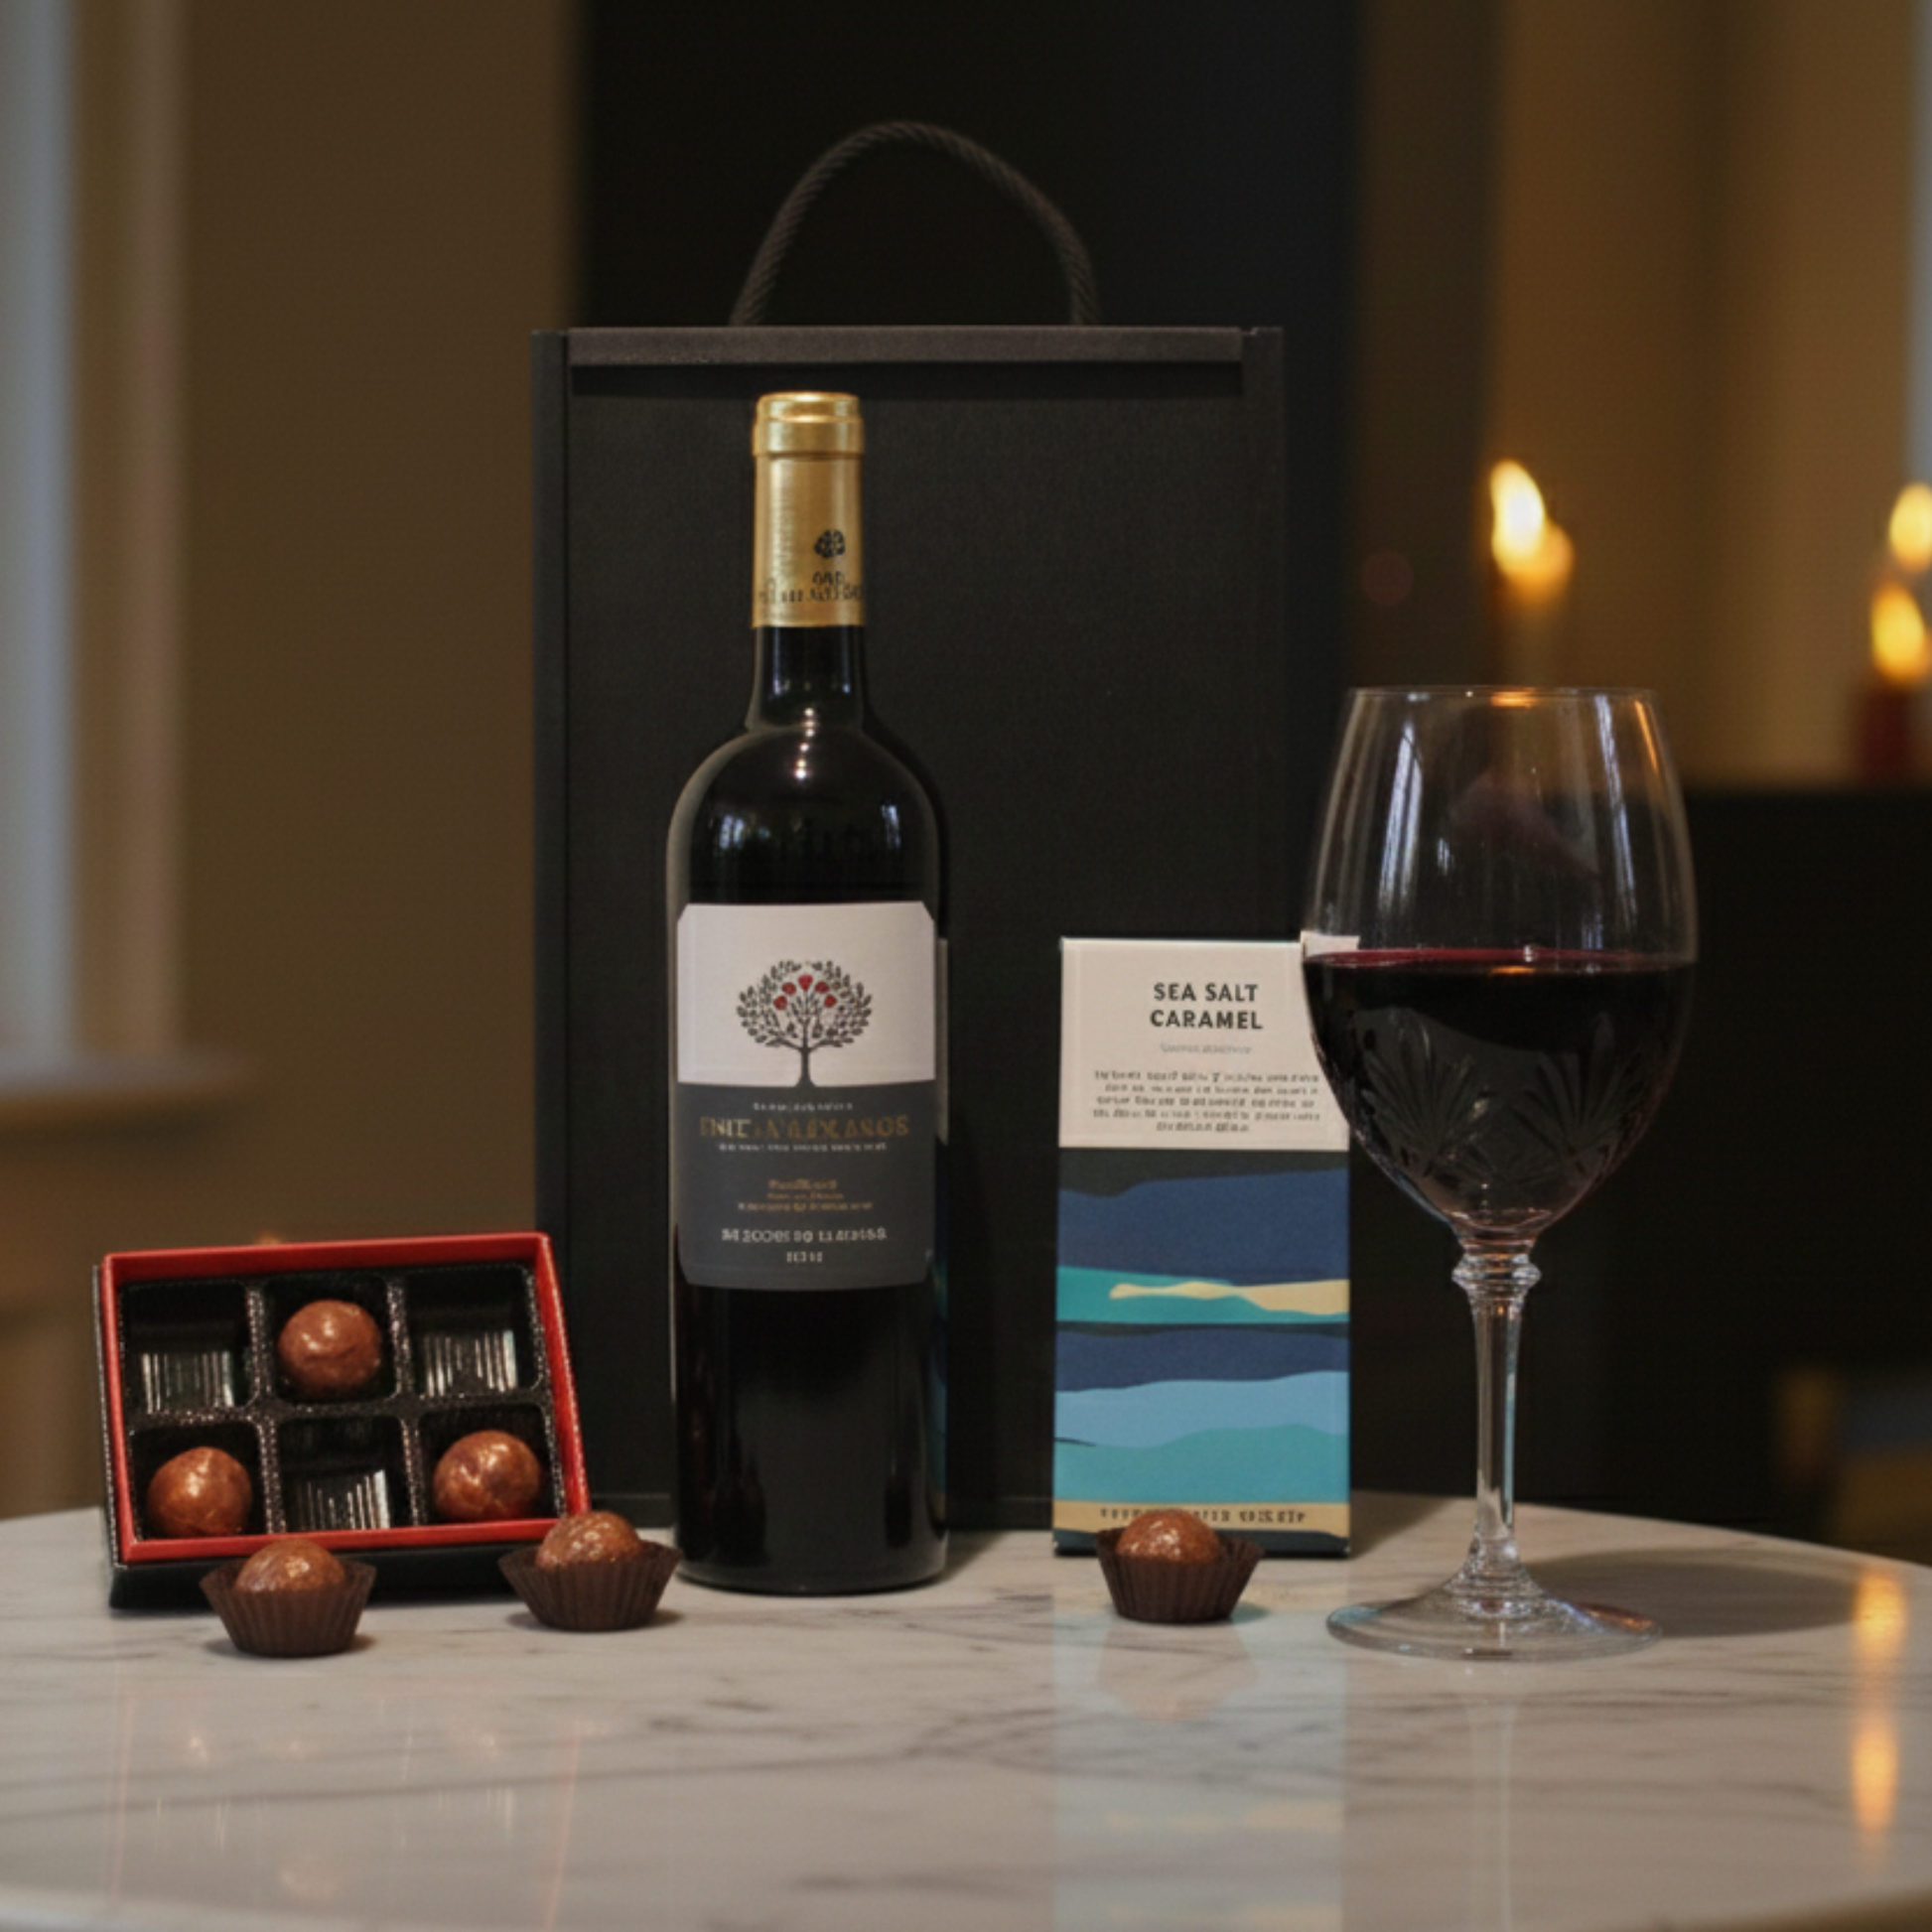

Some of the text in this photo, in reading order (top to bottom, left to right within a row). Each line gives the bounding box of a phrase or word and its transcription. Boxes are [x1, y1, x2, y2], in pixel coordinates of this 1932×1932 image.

[1153, 982, 1259, 1002] SEA SALT
[1150, 1009, 1263, 1030] CARAMEL
